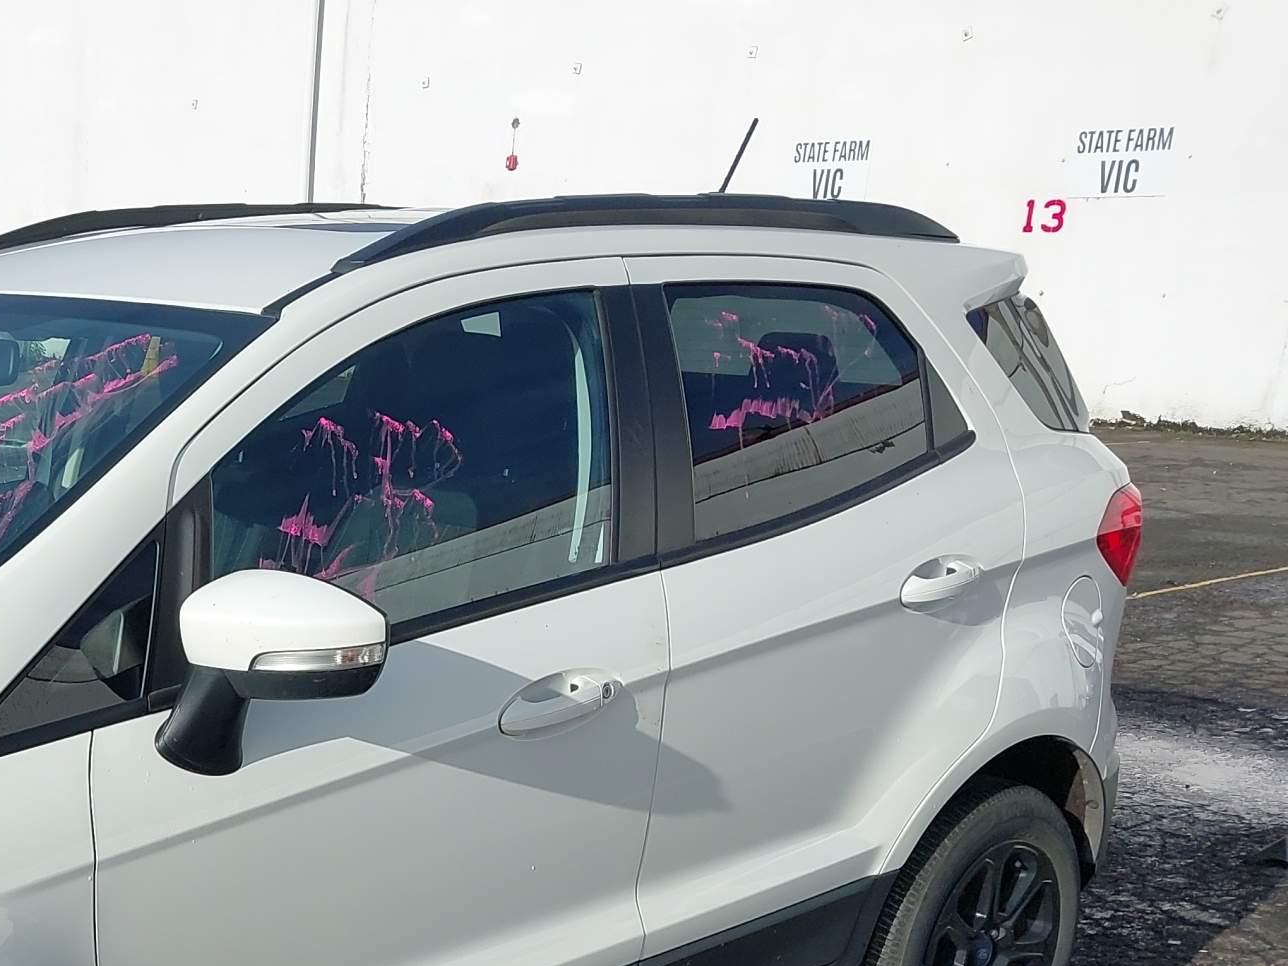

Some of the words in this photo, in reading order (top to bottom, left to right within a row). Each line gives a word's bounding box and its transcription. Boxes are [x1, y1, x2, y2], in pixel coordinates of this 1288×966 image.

[794, 142, 830, 163] STATE
[832, 139, 871, 162] FARM
[1077, 130, 1123, 154] STATE
[1125, 127, 1175, 152] FARM
[812, 168, 844, 199] VIC
[1100, 159, 1140, 194] VIC
[1022, 199, 1067, 233] 13
